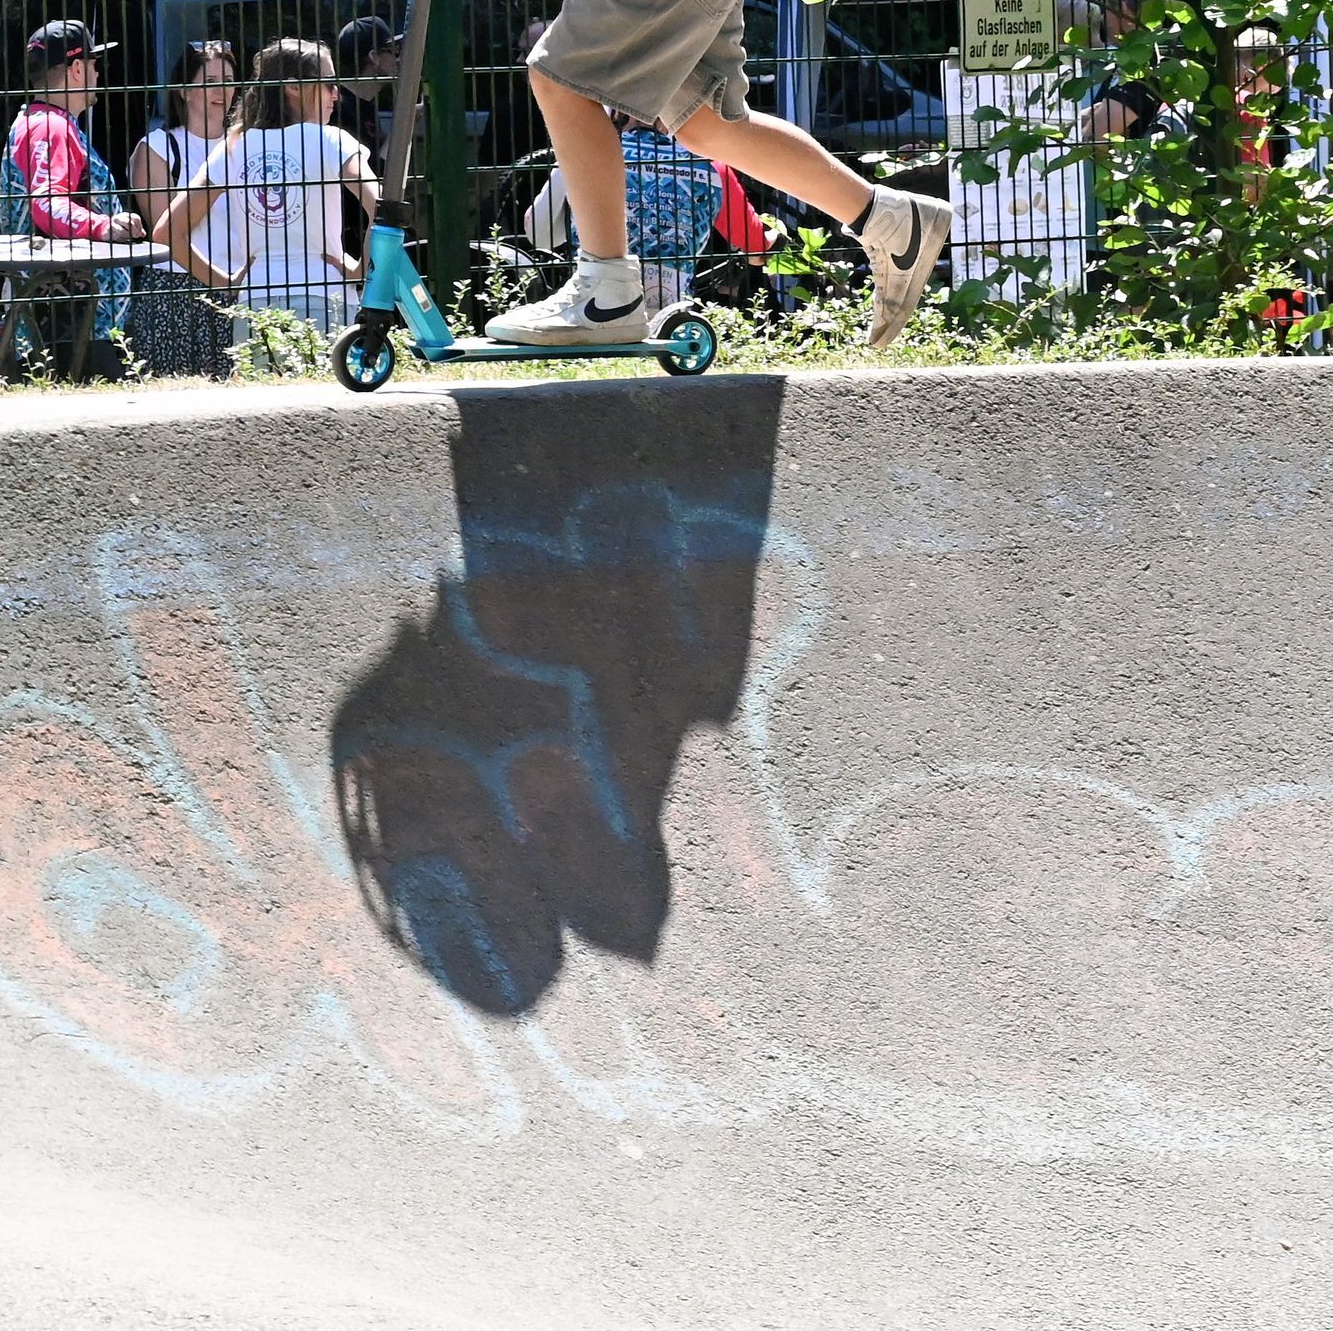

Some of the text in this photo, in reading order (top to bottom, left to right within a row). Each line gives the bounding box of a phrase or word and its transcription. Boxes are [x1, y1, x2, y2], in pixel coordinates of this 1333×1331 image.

[977, 17, 1042, 36] Glasflaschen
[969, 38, 1050, 60] auf der Anlage
